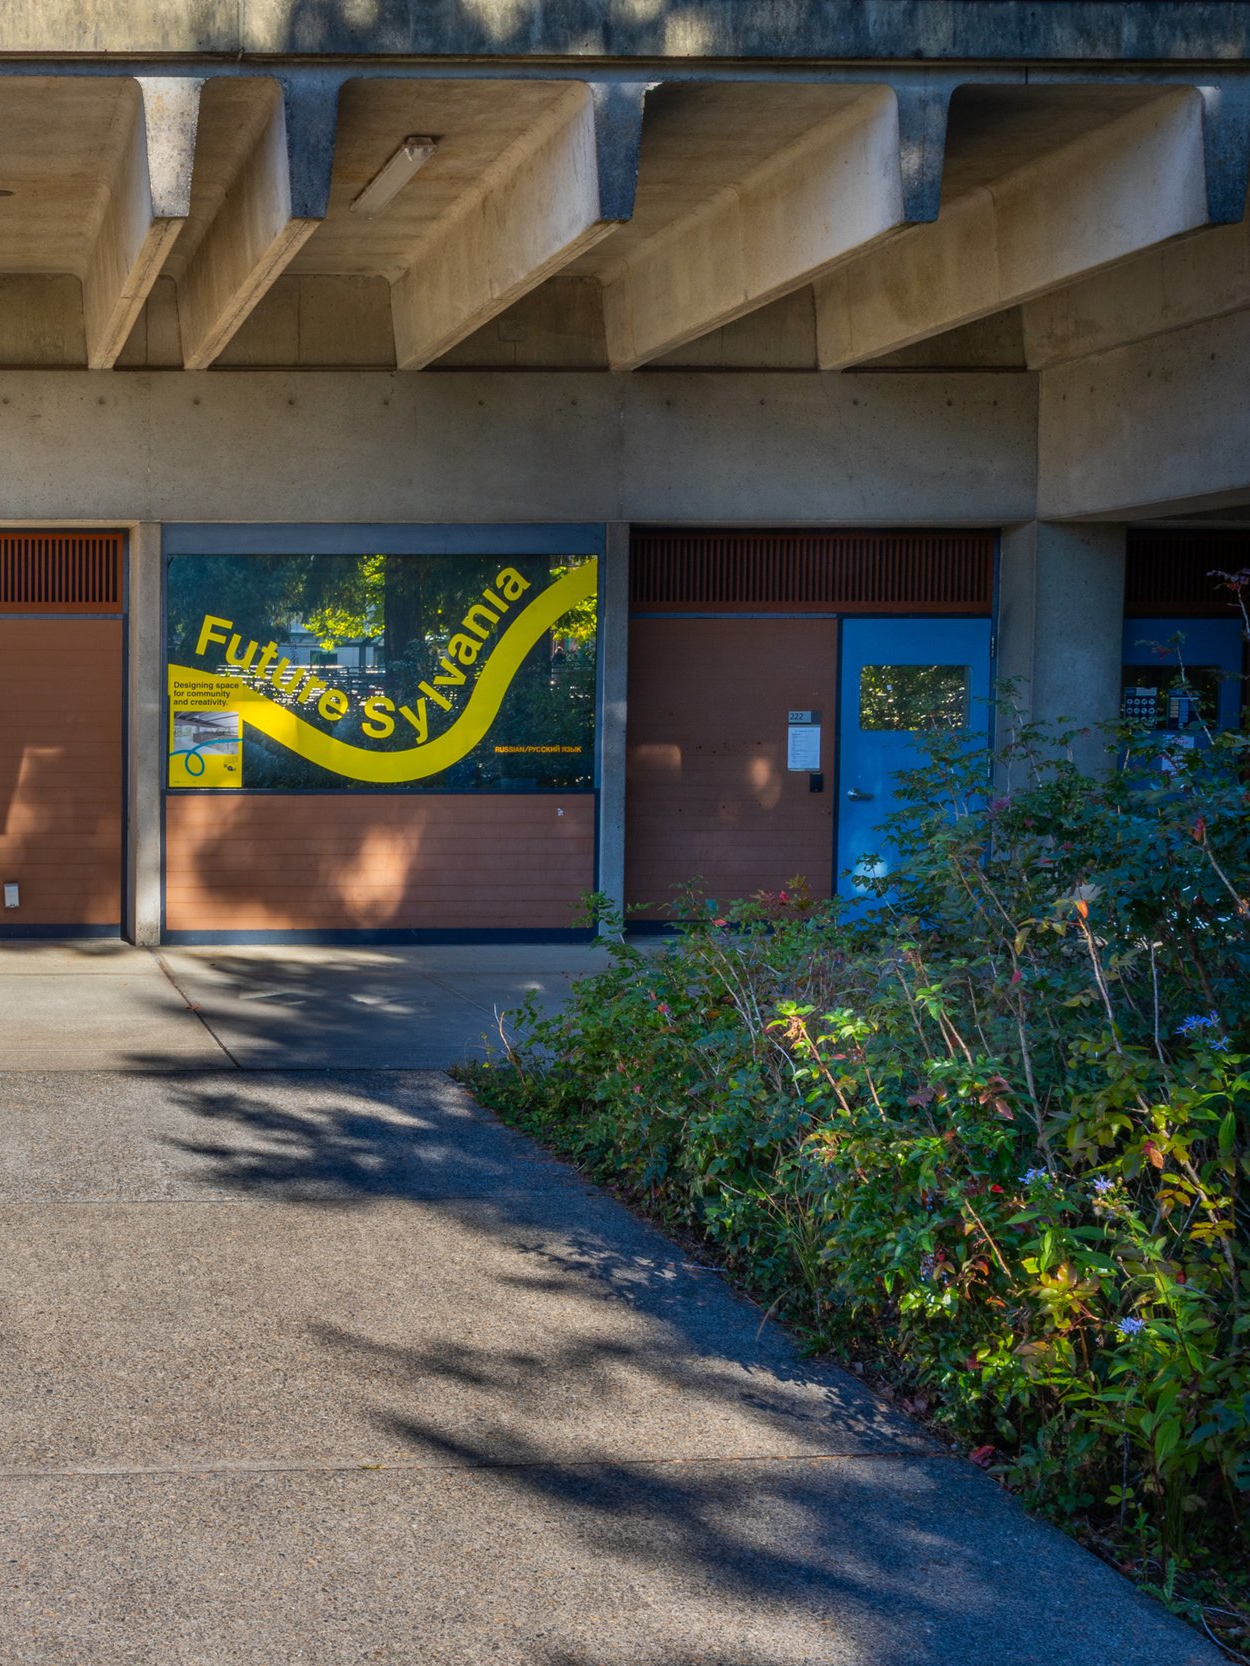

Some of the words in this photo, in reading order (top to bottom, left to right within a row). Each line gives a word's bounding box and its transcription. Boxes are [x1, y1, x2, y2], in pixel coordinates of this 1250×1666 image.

[195, 614, 349, 721] Future
[361, 567, 532, 745] Sylvania
[173, 681, 214, 690] Designing
[215, 682, 240, 690] space
[186, 690, 231, 698] community
[190, 699, 228, 707] creativity.
[790, 712, 804, 721] 222
[561, 745, 582, 753] ЯЗЫК
